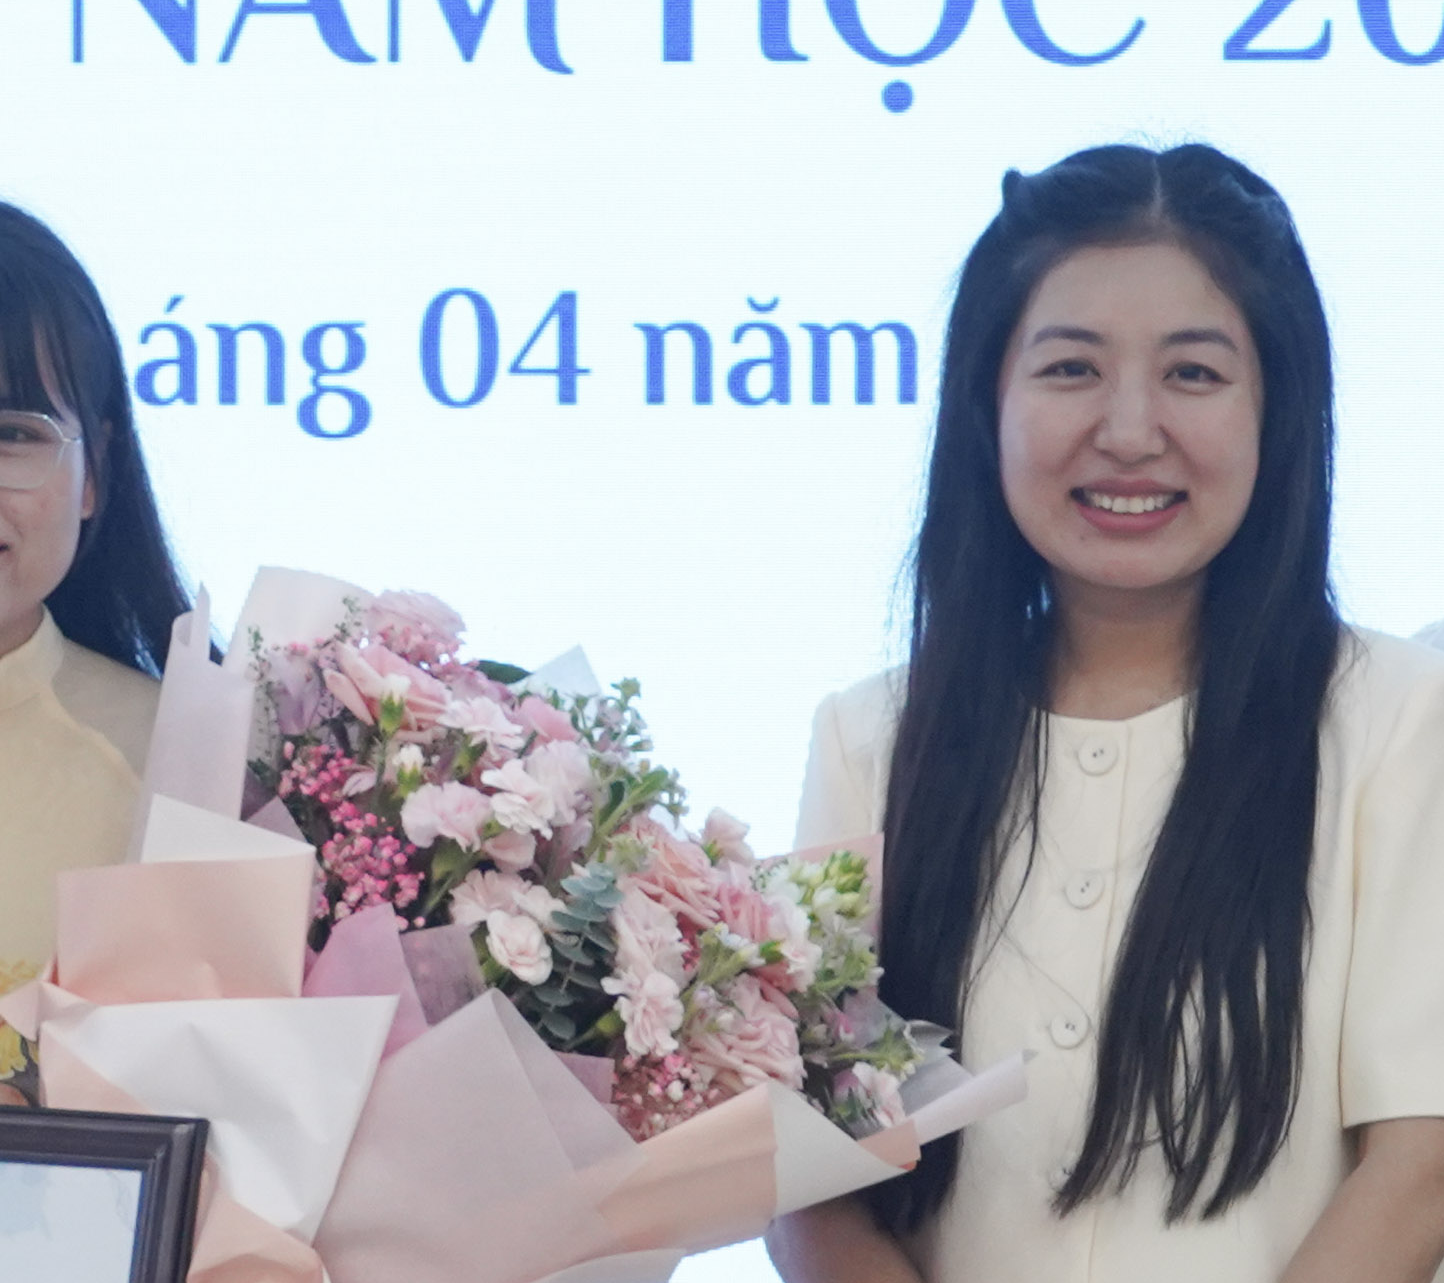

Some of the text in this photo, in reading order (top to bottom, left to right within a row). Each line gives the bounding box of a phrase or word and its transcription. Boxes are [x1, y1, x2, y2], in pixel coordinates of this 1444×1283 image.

[132, 294, 372, 440] áng
[419, 287, 591, 409] 04
[633, 297, 919, 407] năm
